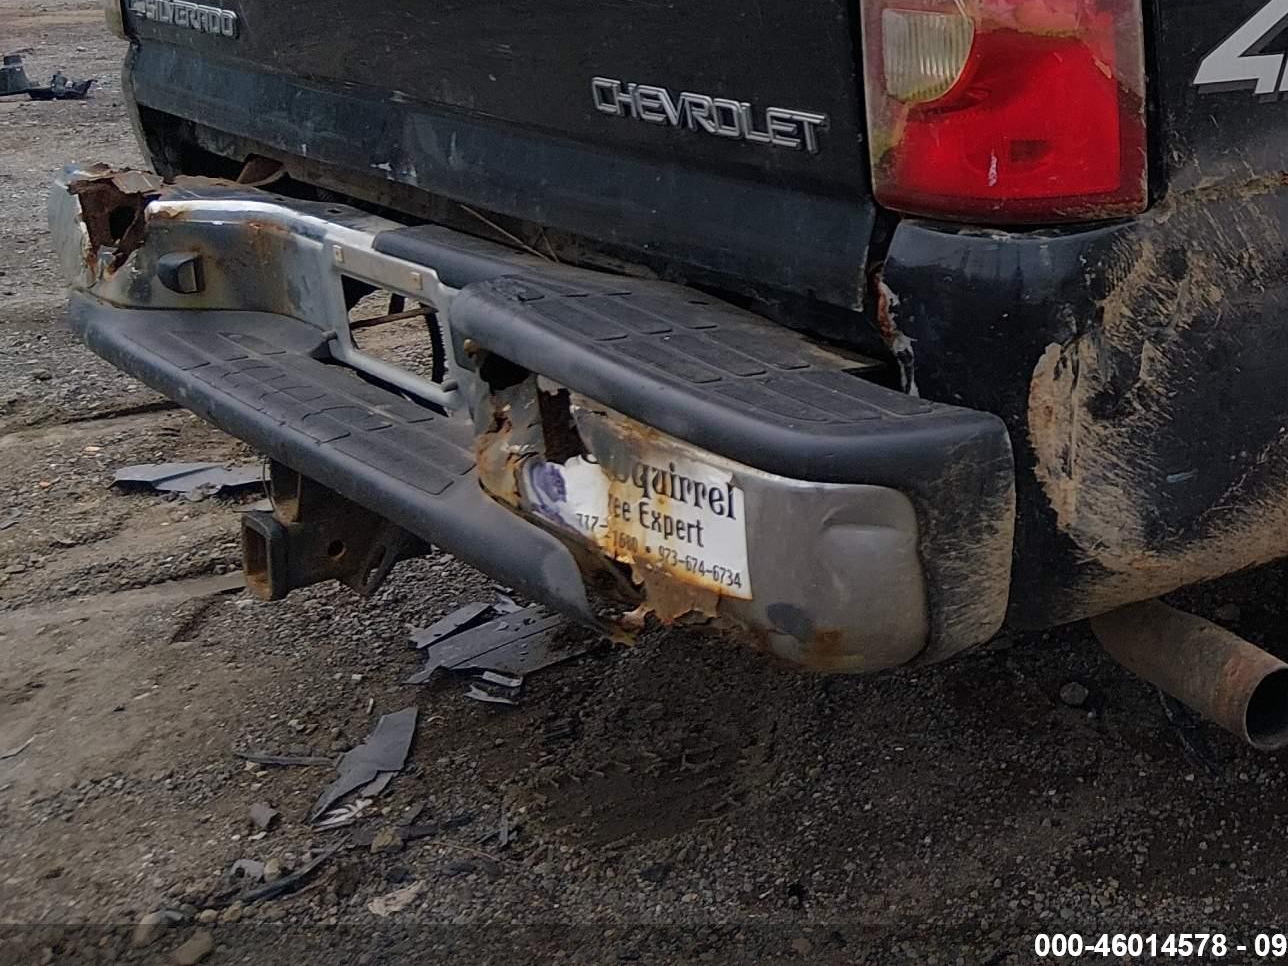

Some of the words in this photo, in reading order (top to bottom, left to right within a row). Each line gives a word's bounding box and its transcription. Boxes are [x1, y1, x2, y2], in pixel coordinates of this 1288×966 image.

[591, 76, 828, 154] CHEVROLET
[638, 501, 705, 548] Expert
[658, 545, 743, 589] 973-674-6734
